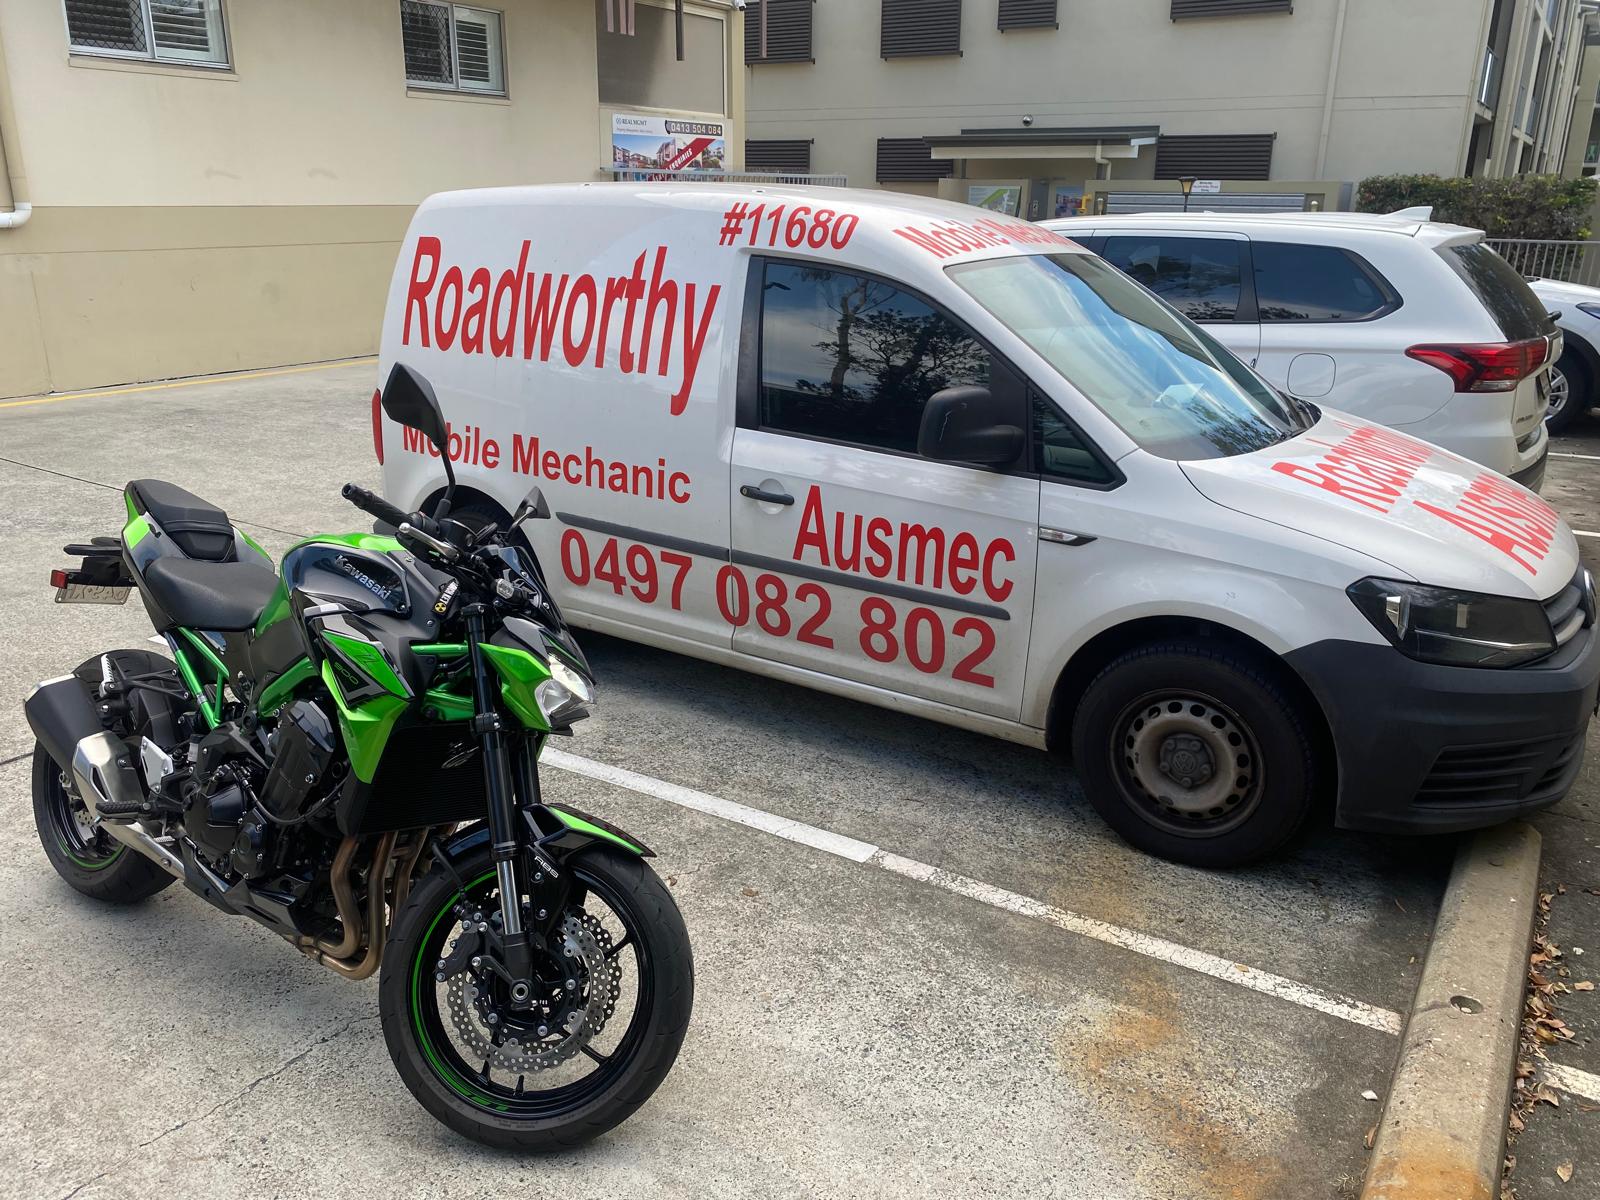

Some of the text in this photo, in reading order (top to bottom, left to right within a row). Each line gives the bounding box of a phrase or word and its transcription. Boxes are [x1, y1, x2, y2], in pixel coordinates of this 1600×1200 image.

[671, 124, 721, 135] 0413 504 084
[719, 202, 860, 250] #11680
[892, 219, 1011, 259] Mobile
[402, 236, 722, 417] Roadworthy
[512, 433, 692, 504] Mechanic
[793, 485, 1016, 602] Ausmec
[334, 554, 392, 601] Kawasaki
[560, 527, 996, 689] 0497 082 802
[333, 661, 359, 685] 900
[534, 855, 559, 879] ABS
